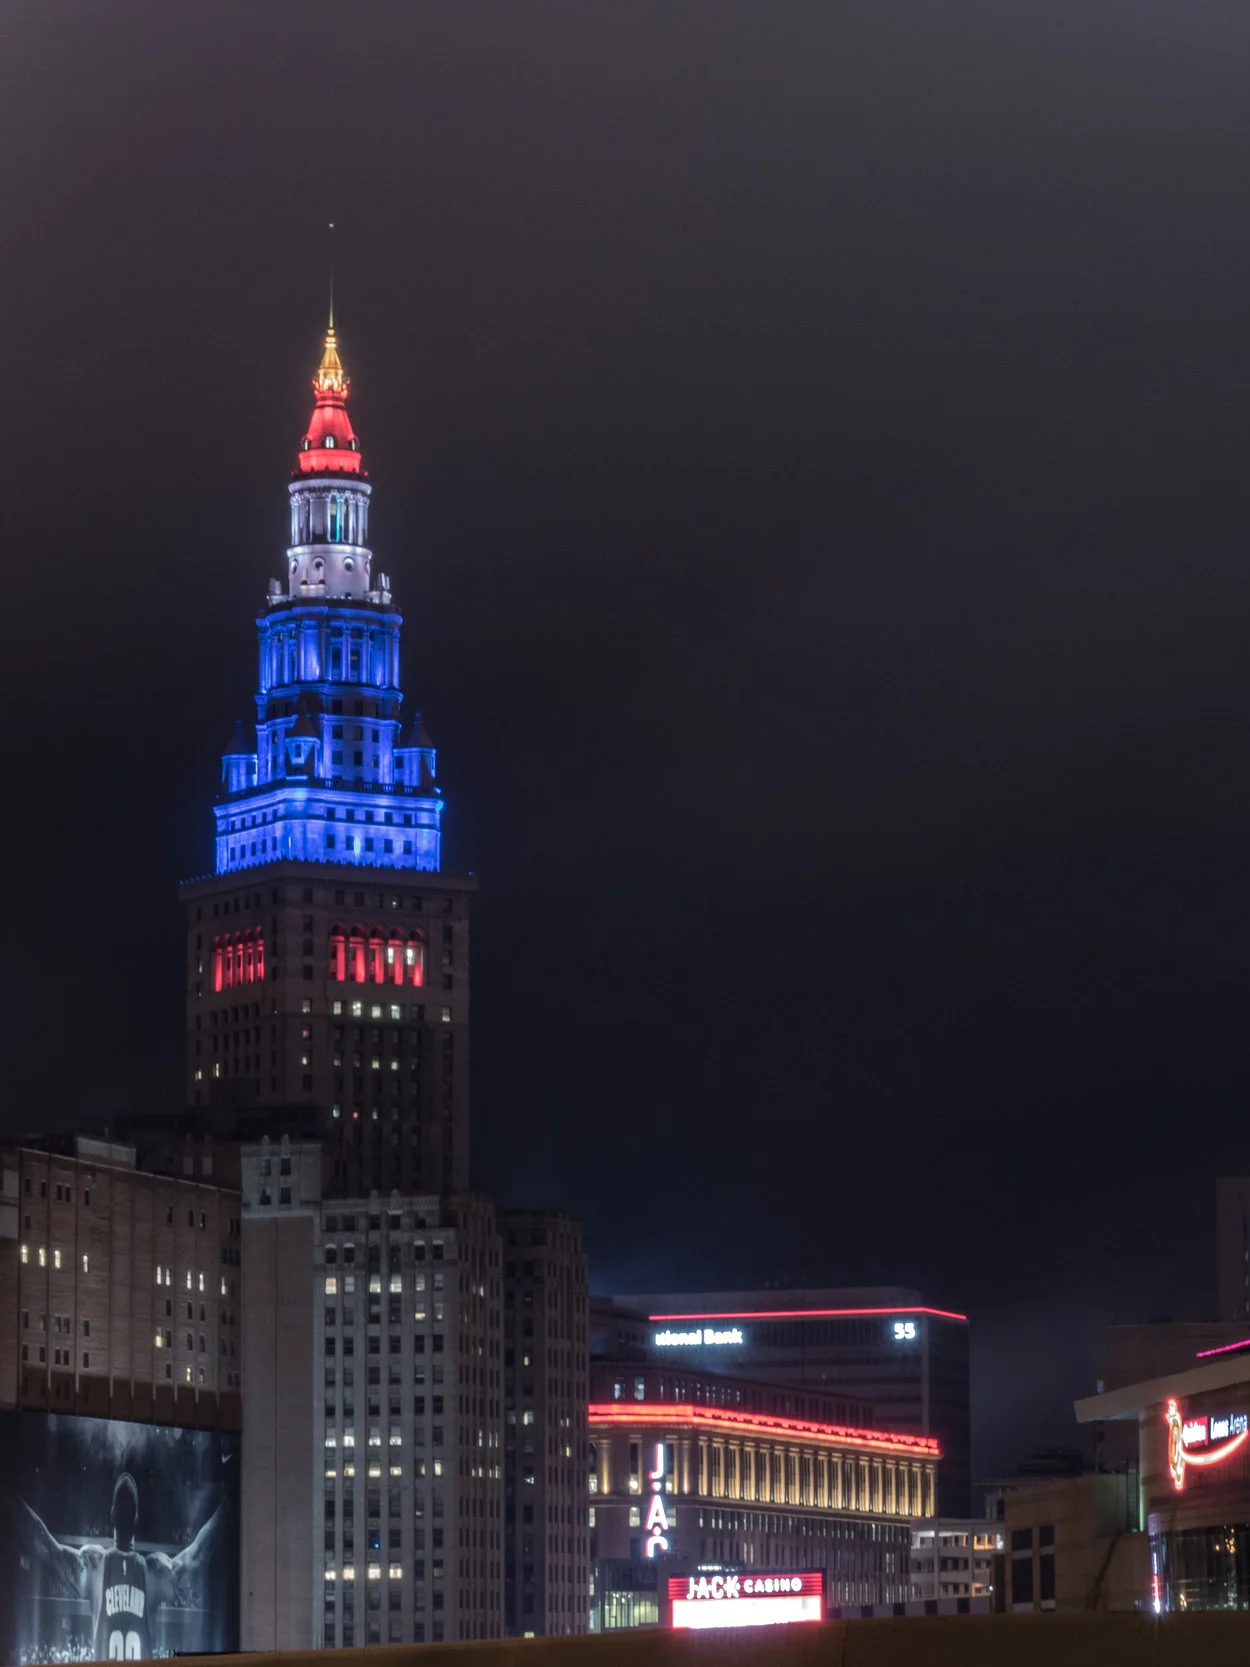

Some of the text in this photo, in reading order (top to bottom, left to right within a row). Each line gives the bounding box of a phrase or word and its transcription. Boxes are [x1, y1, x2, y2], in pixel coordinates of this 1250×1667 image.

[703, 1328, 743, 1345] Bank
[893, 1322, 916, 1340] 55
[686, 1575, 802, 1599] JACK CASINO
[105, 1584, 145, 1618] CLEVELAND
